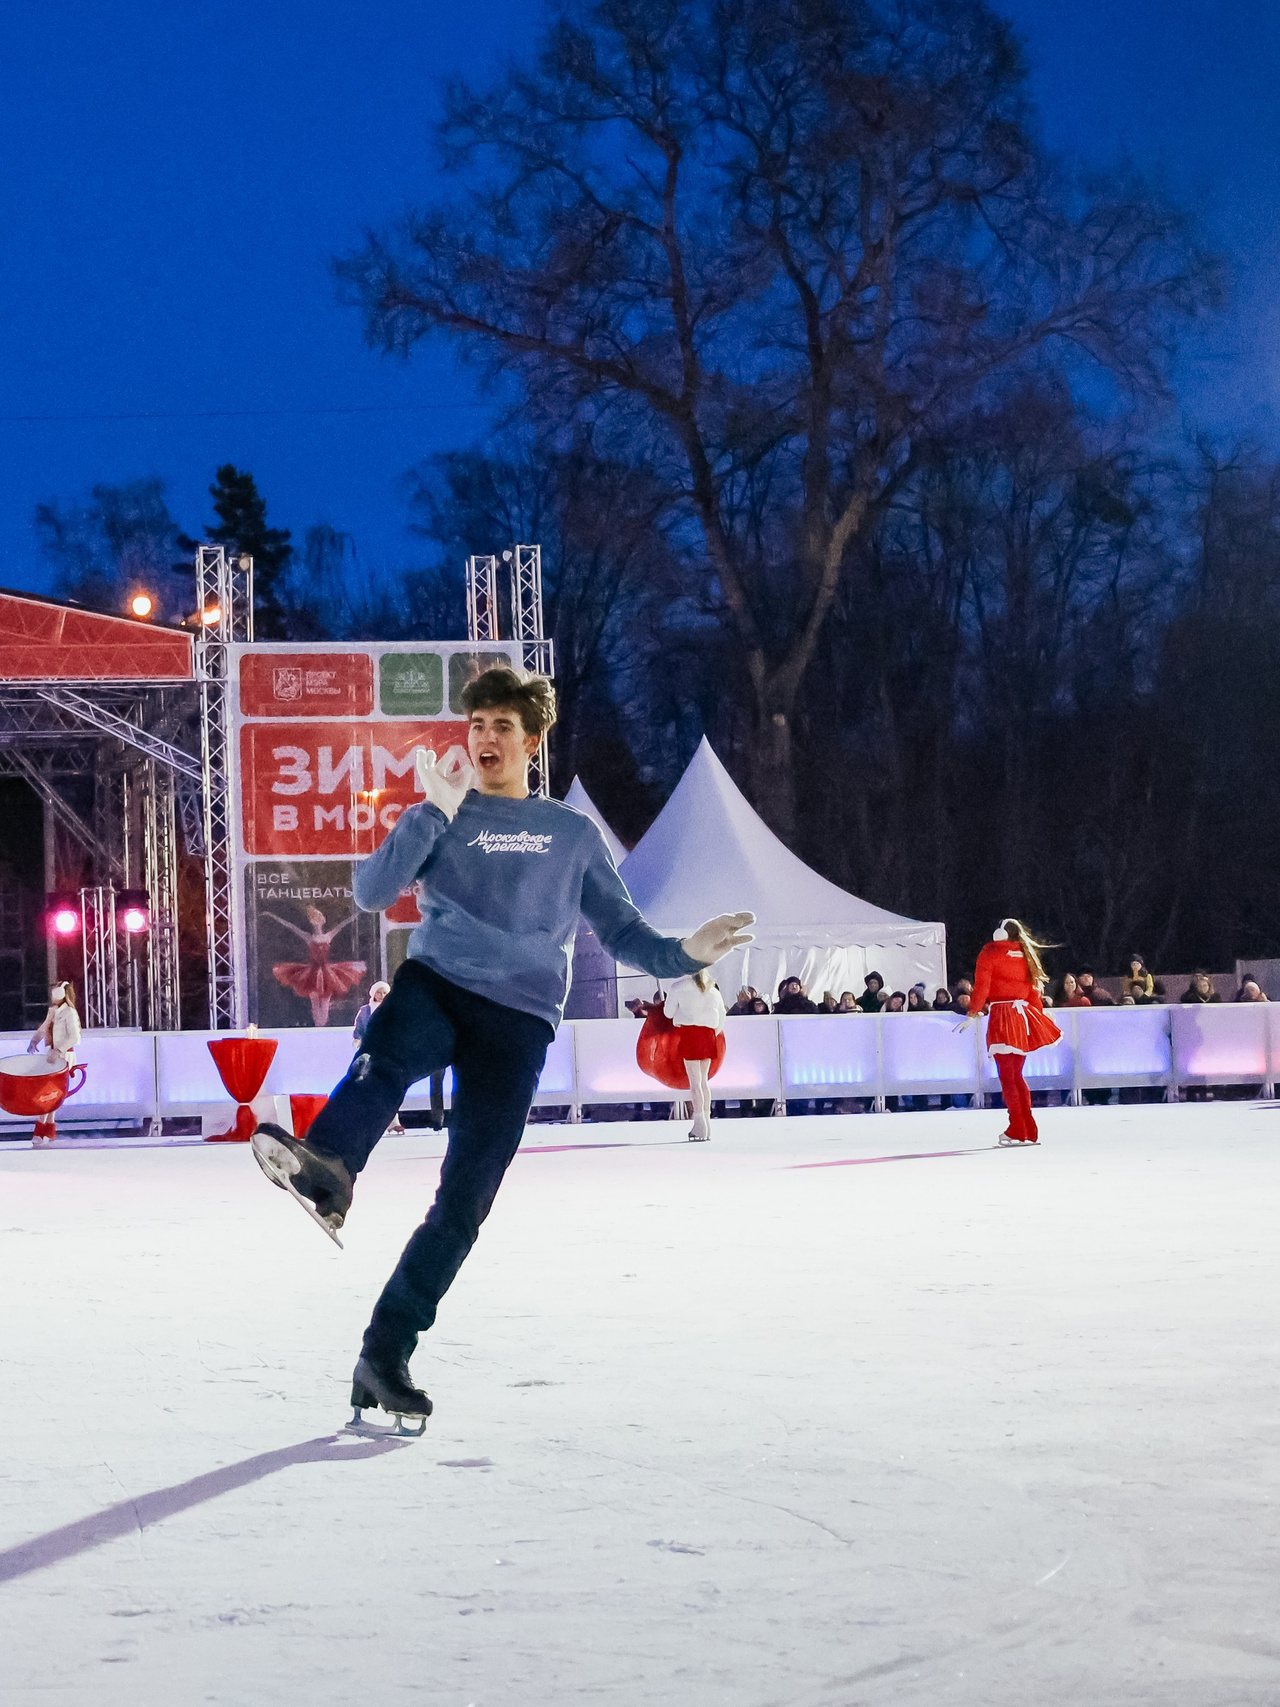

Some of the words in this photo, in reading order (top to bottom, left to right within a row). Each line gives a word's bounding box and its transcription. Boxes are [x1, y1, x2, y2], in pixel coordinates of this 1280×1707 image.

[305, 687, 341, 695] МОСКВЫ
[273, 805, 298, 831] В
[257, 873, 290, 885] ВСЕ
